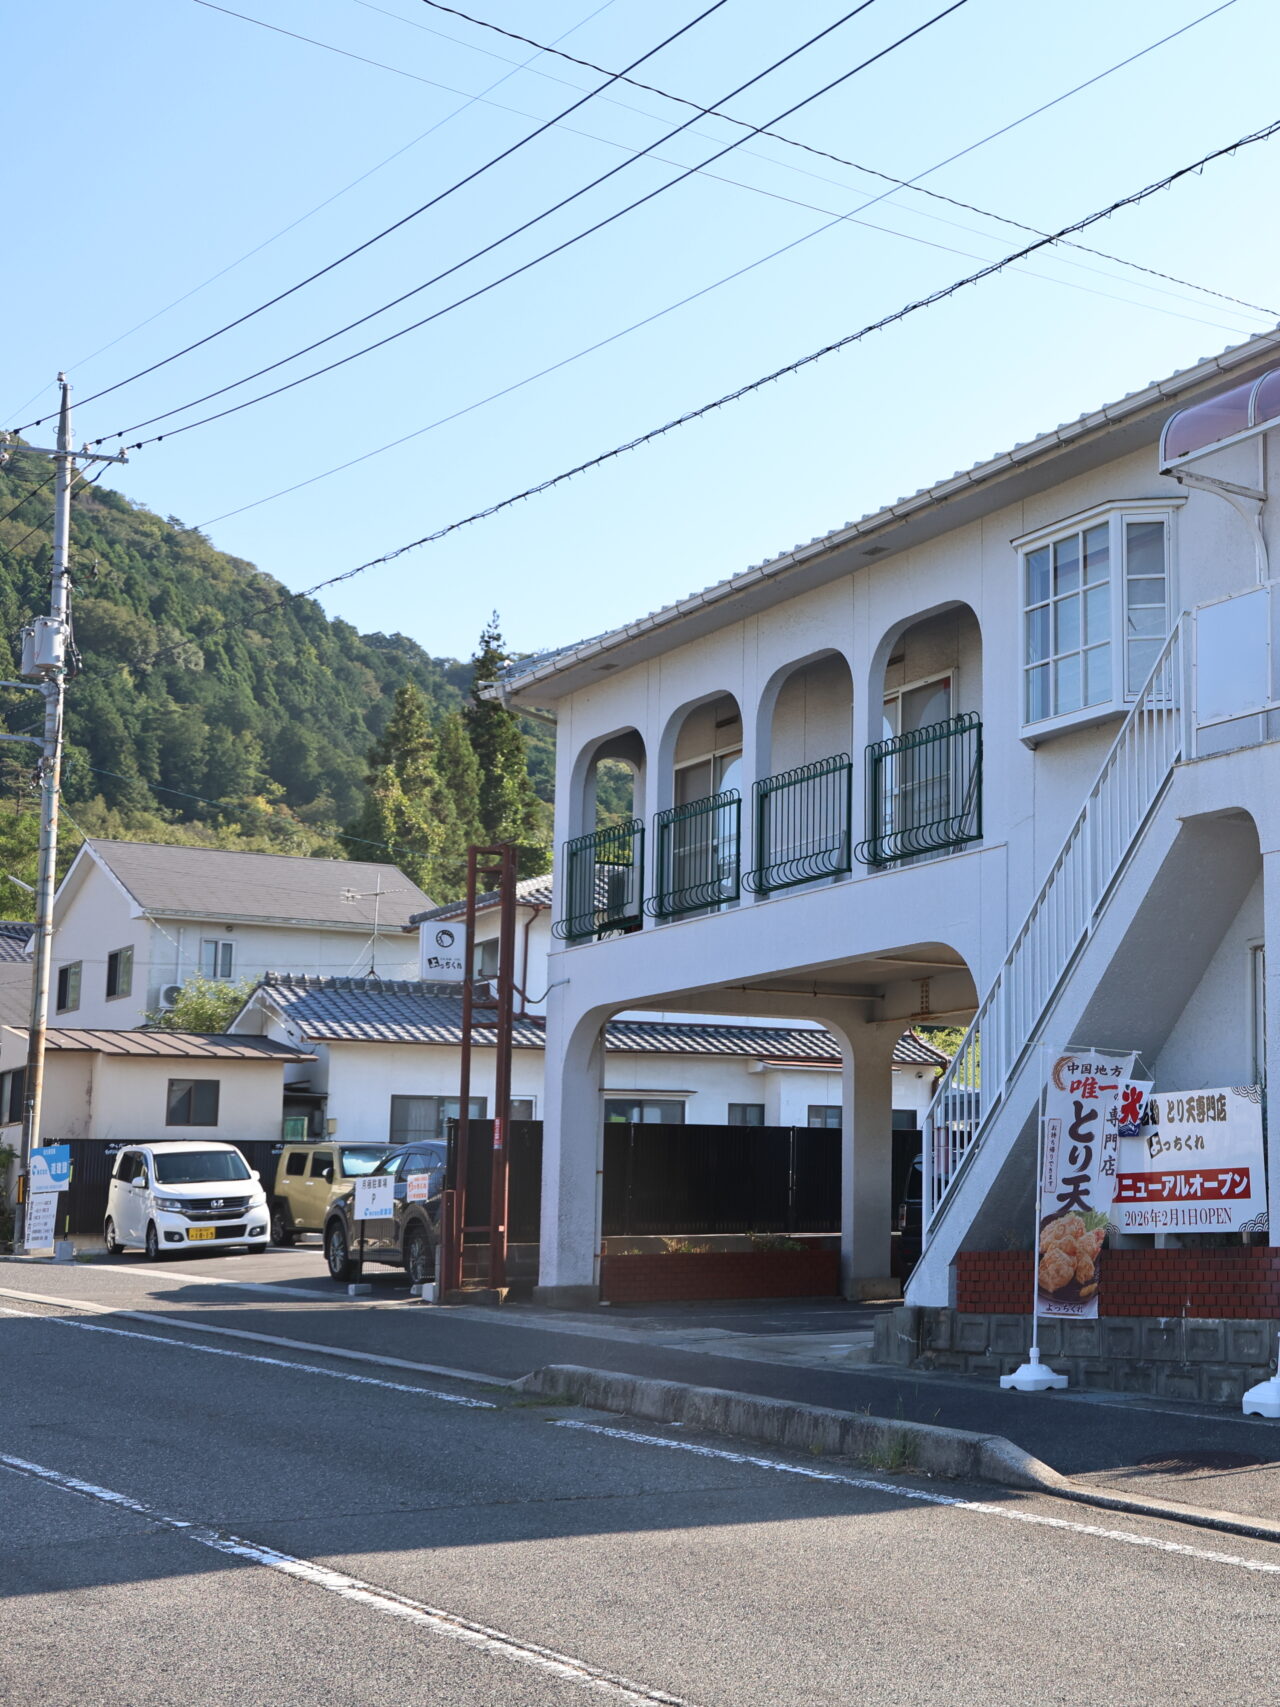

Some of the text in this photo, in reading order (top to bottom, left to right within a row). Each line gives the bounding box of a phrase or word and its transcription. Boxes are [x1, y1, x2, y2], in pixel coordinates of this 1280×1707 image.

[1067, 1062, 1123, 1078] 中国地方
[1069, 1076, 1119, 1100] 唯一
[1119, 1085, 1144, 1125] 氷
[1057, 1100, 1099, 1213] とり天
[1147, 1132, 1205, 1159] よっちくれ
[1124, 1207, 1233, 1228] 2026年2月1日OPEN
[1046, 1303, 1083, 1313] よっちくれ
